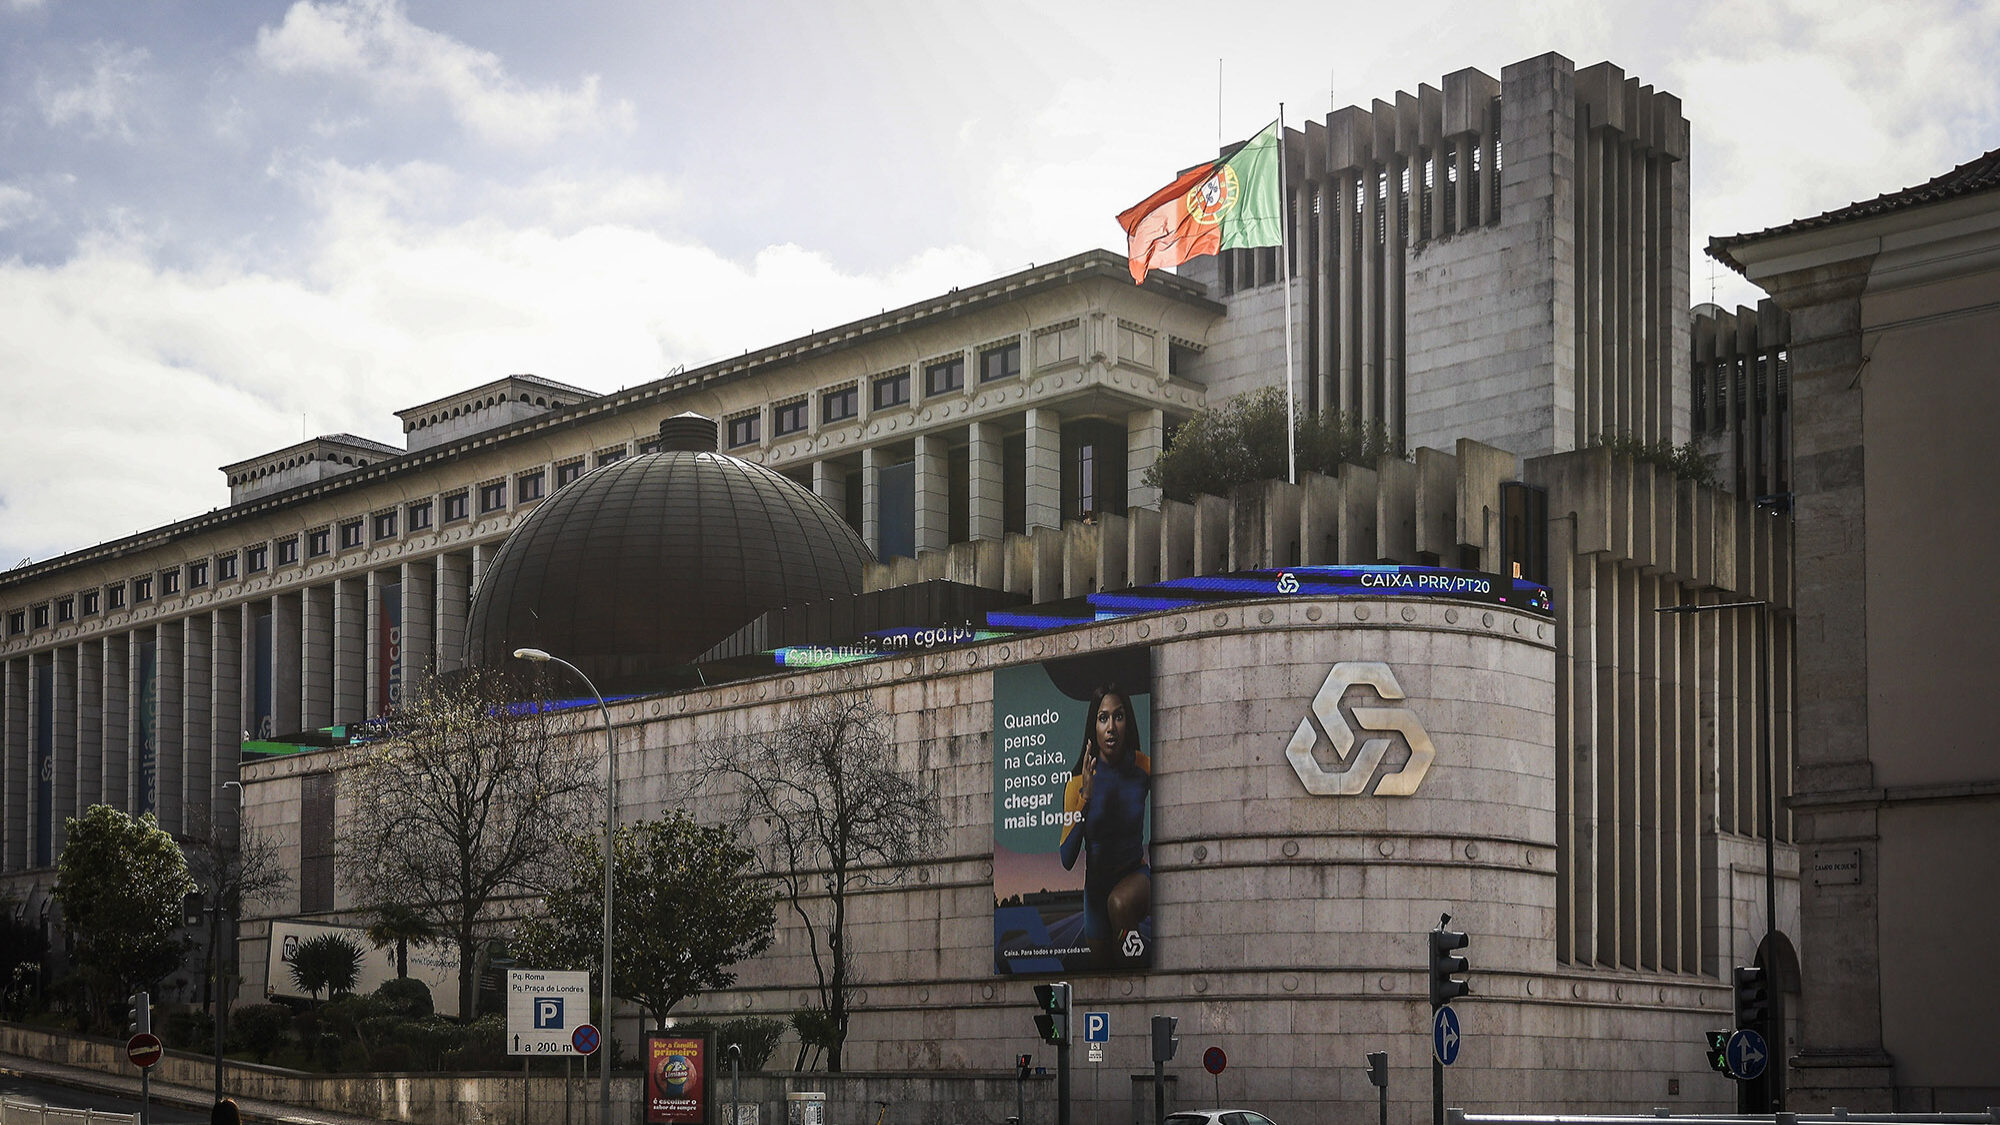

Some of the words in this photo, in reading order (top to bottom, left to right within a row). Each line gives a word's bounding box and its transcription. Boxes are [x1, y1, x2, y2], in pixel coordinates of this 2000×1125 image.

[1360, 573, 1413, 588] CAIXA
[1418, 574, 1490, 594] PRR/PT20
[882, 635, 908, 651] em
[914, 619, 972, 648] cgd.pt
[1004, 709, 1059, 729] Quando
[142, 678, 157, 817] esiliência
[1004, 733, 1046, 752] penso
[1004, 756, 1020, 770] na
[1025, 750, 1066, 767] Caixa,
[1004, 774, 1046, 792] penso
[1051, 770, 1072, 784] em
[1004, 793, 1053, 809] chegar
[1004, 812, 1037, 829] mais
[1041, 810, 1085, 826] longe.
[512, 973, 524, 981] Pq.
[512, 984, 524, 993] Pq.
[525, 985, 545, 993] Praça
[541, 1003, 557, 1026] P
[1089, 1015, 1104, 1040] P
[525, 1044, 531, 1052] a
[537, 1043, 557, 1052] 200
[562, 1044, 572, 1052] m
[654, 1048, 698, 1058] primeiro
